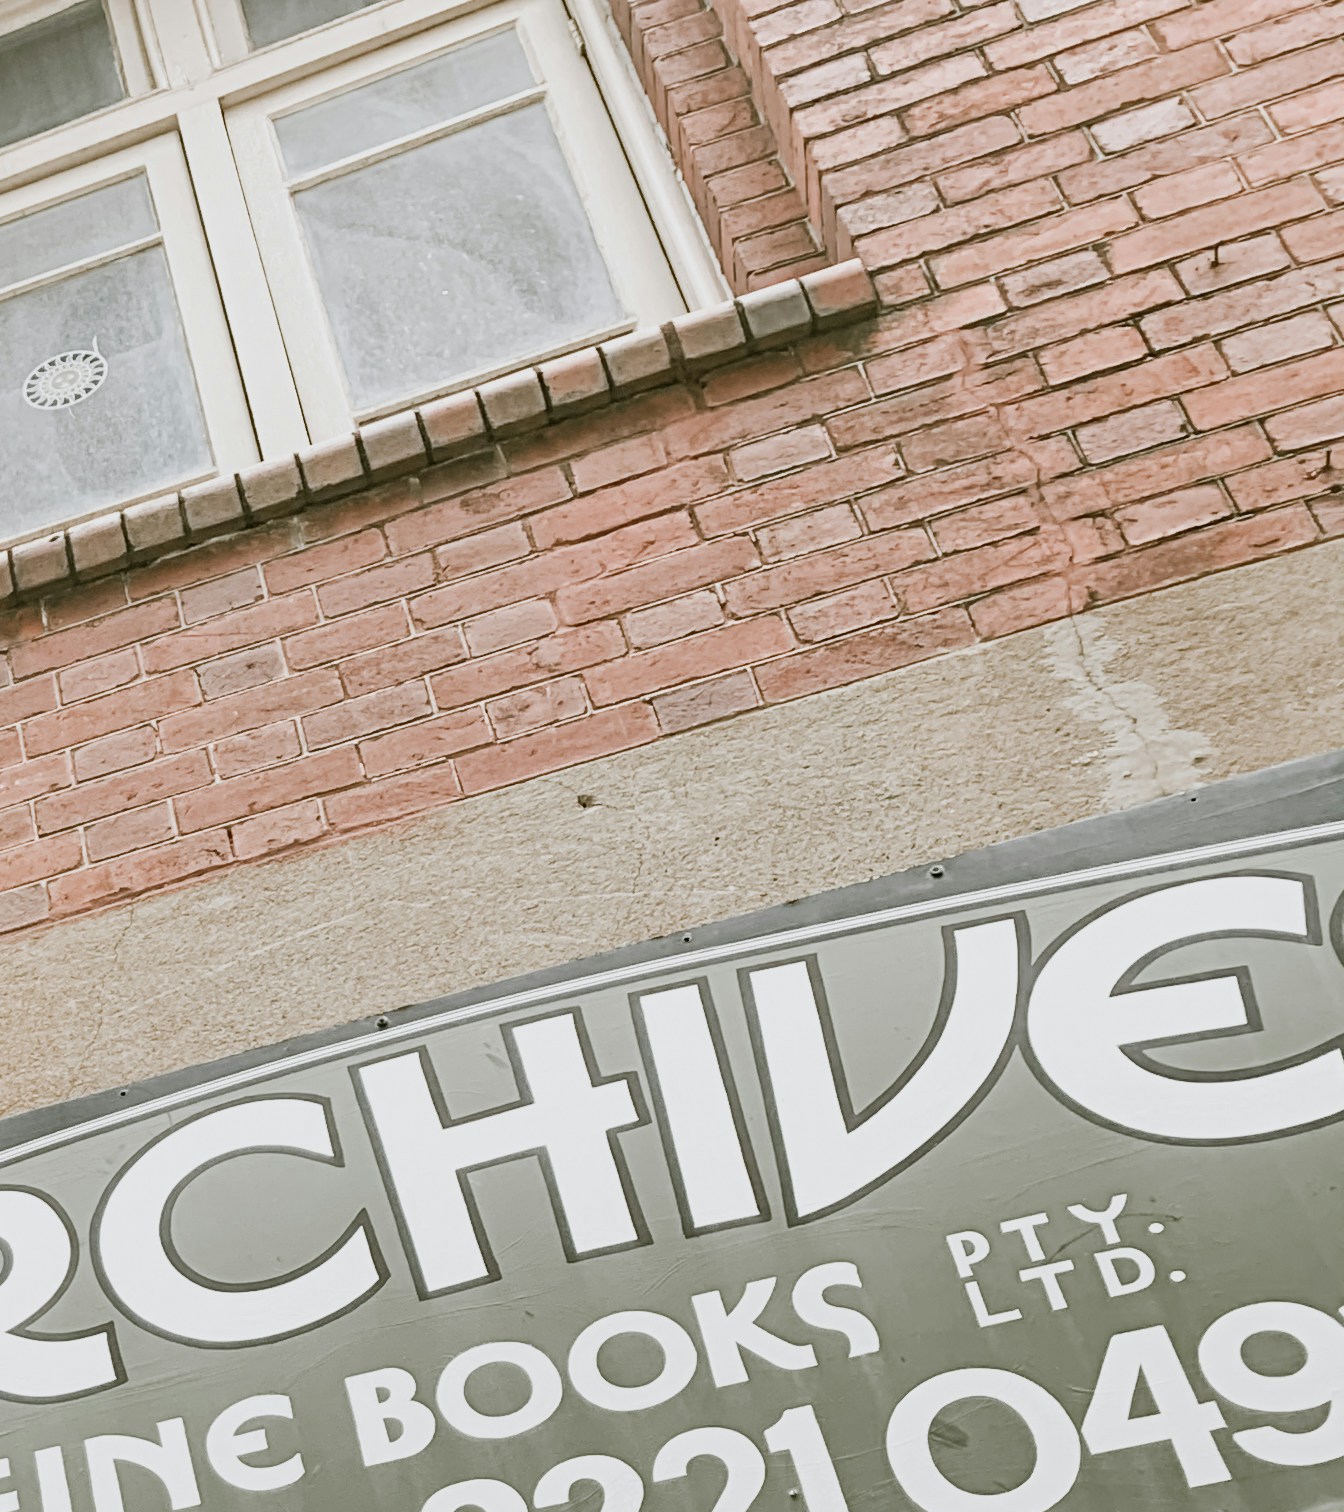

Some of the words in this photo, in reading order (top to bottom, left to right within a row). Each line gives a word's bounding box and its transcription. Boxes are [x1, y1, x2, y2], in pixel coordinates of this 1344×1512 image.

[946, 1193, 1164, 1278] PTY.
[965, 1247, 1186, 1328] LTD.
[344, 1261, 880, 1467] BOOKS
